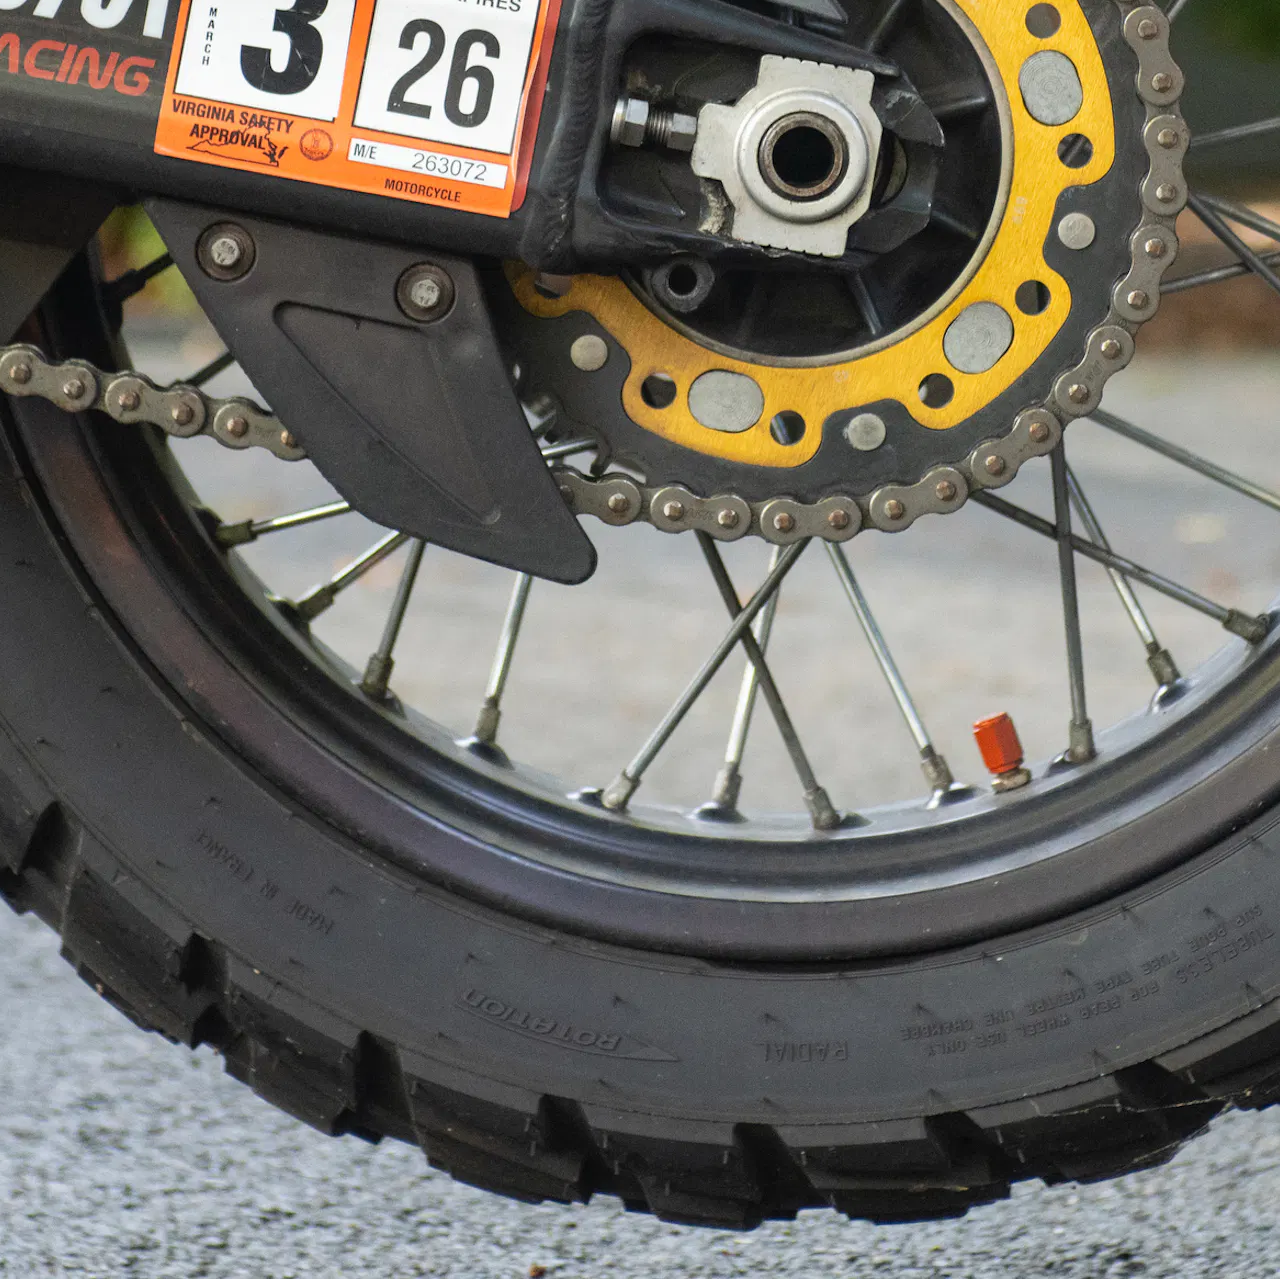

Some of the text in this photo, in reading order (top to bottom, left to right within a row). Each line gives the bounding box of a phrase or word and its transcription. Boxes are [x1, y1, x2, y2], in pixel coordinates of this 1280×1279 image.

[201, 7, 218, 66] MARCH
[387, 18, 501, 128] 26
[172, 98, 294, 135] VIRGINIA SAFETY
[189, 123, 266, 150] APPROVAL
[353, 142, 378, 160] M/E
[412, 151, 488, 182] 263072
[384, 177, 462, 203] MOTORCYCLE
[1175, 925, 1276, 984] TUBELESS
[1131, 981, 1160, 1002] FOR
[464, 988, 622, 1052] ROTATION
[759, 1040, 849, 1063] RADIAL
